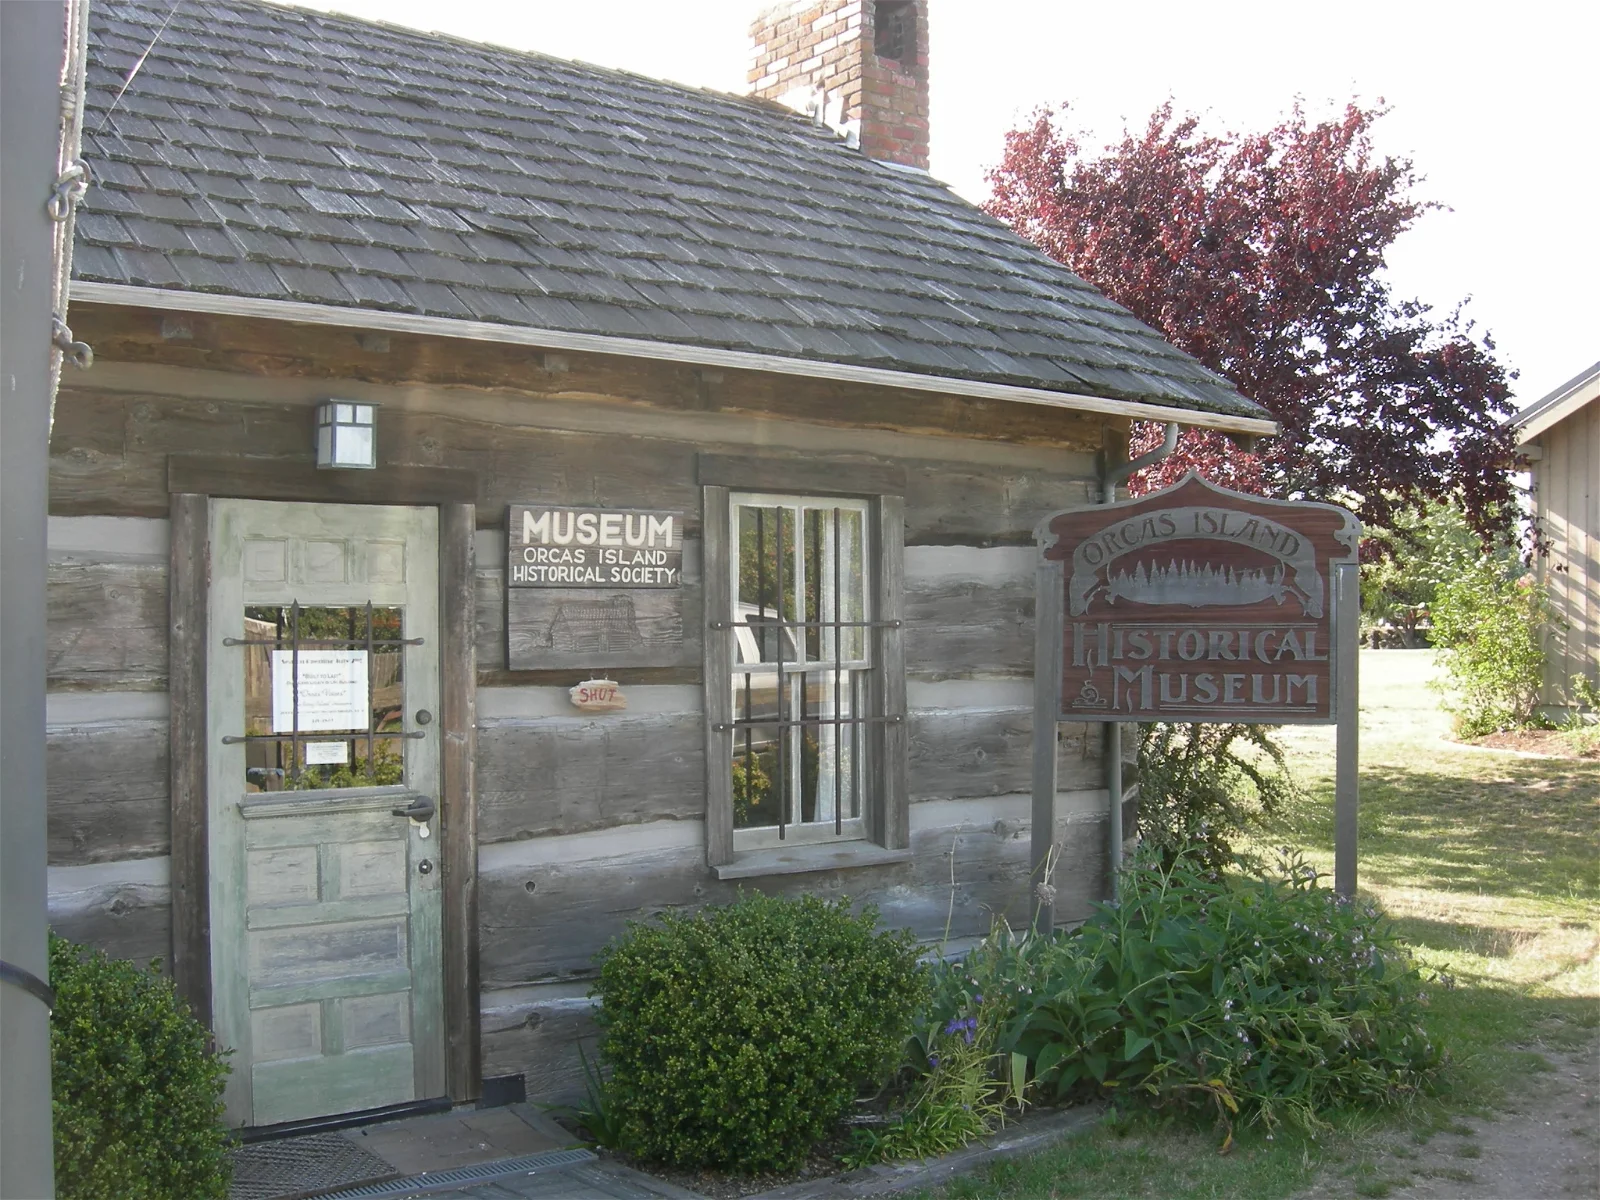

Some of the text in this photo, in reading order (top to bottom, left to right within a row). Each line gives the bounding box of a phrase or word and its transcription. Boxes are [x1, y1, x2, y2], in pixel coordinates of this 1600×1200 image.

[522, 510, 674, 548] MUSEUM
[1082, 511, 1301, 566] ORCAS ISLAND
[513, 565, 676, 584] HISTORICAL SOCIETY
[523, 547, 668, 566] ORCAS ISLAND
[1072, 622, 1328, 669] HISTORICAL
[579, 688, 618, 703] SHUT
[1112, 665, 1319, 712] MUSEUM
